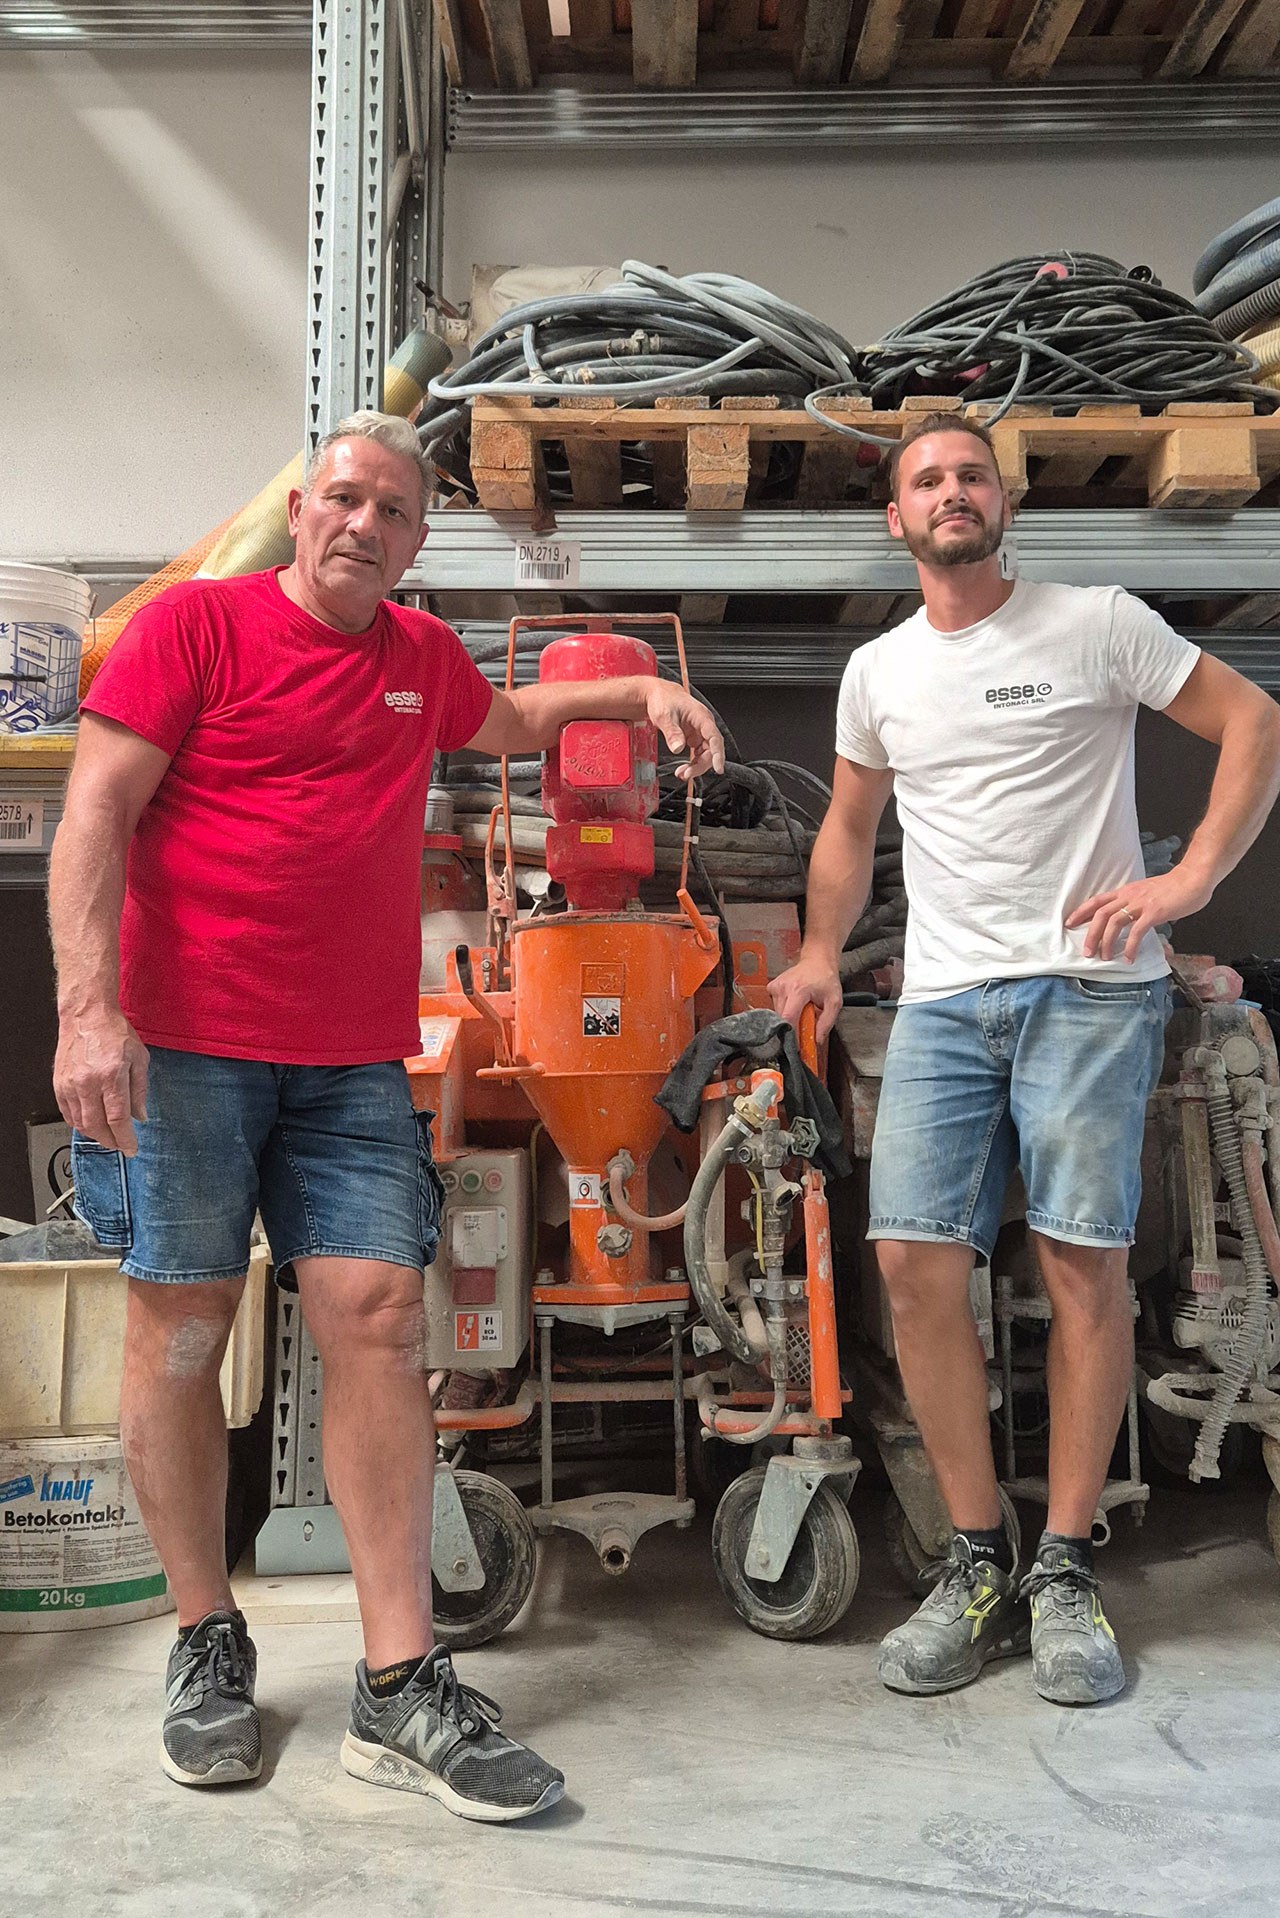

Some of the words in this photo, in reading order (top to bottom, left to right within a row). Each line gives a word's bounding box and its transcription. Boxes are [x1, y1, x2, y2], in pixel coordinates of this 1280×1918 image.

[993, 699, 1029, 709] INTONACI
[485, 1316, 493, 1325] FI
[40, 1472, 94, 1507] KNAUF
[4, 1504, 127, 1527] Betokontakt
[39, 1590, 61, 1606] 20
[63, 1588, 85, 1608] kg
[369, 1665, 409, 1687] WORK
